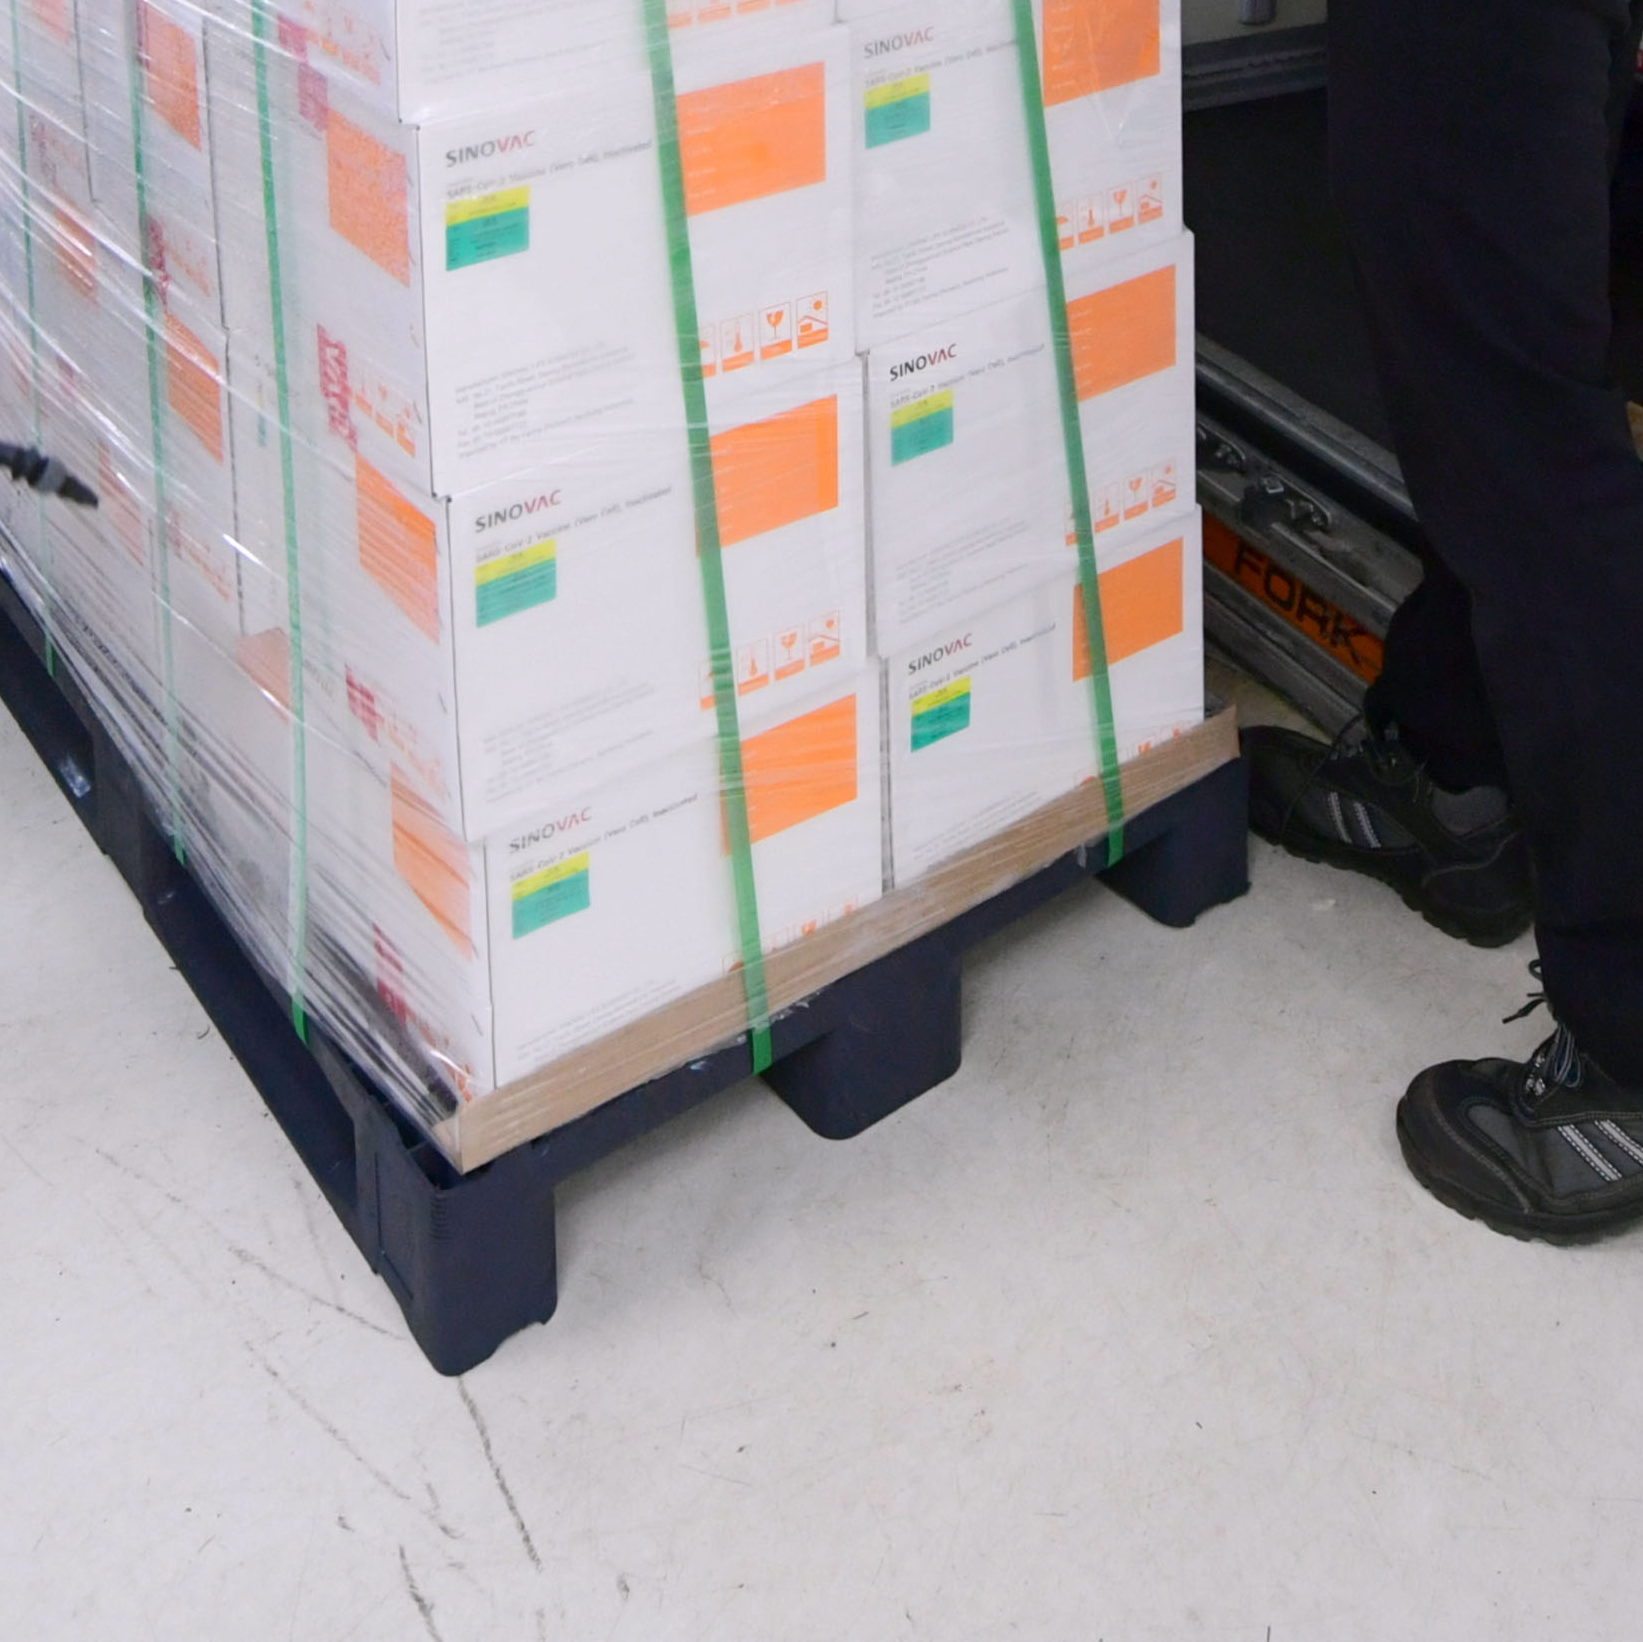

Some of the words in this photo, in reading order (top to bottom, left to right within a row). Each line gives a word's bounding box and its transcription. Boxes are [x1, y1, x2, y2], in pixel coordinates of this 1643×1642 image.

[864, 25, 935, 59] SINOVAC
[446, 130, 535, 168] SINOVAC
[889, 342, 957, 382] SINOVAC
[474, 488, 562, 534] SINOVAC
[907, 631, 974, 676] SINOVAC
[509, 805, 593, 854] SINOVAC
